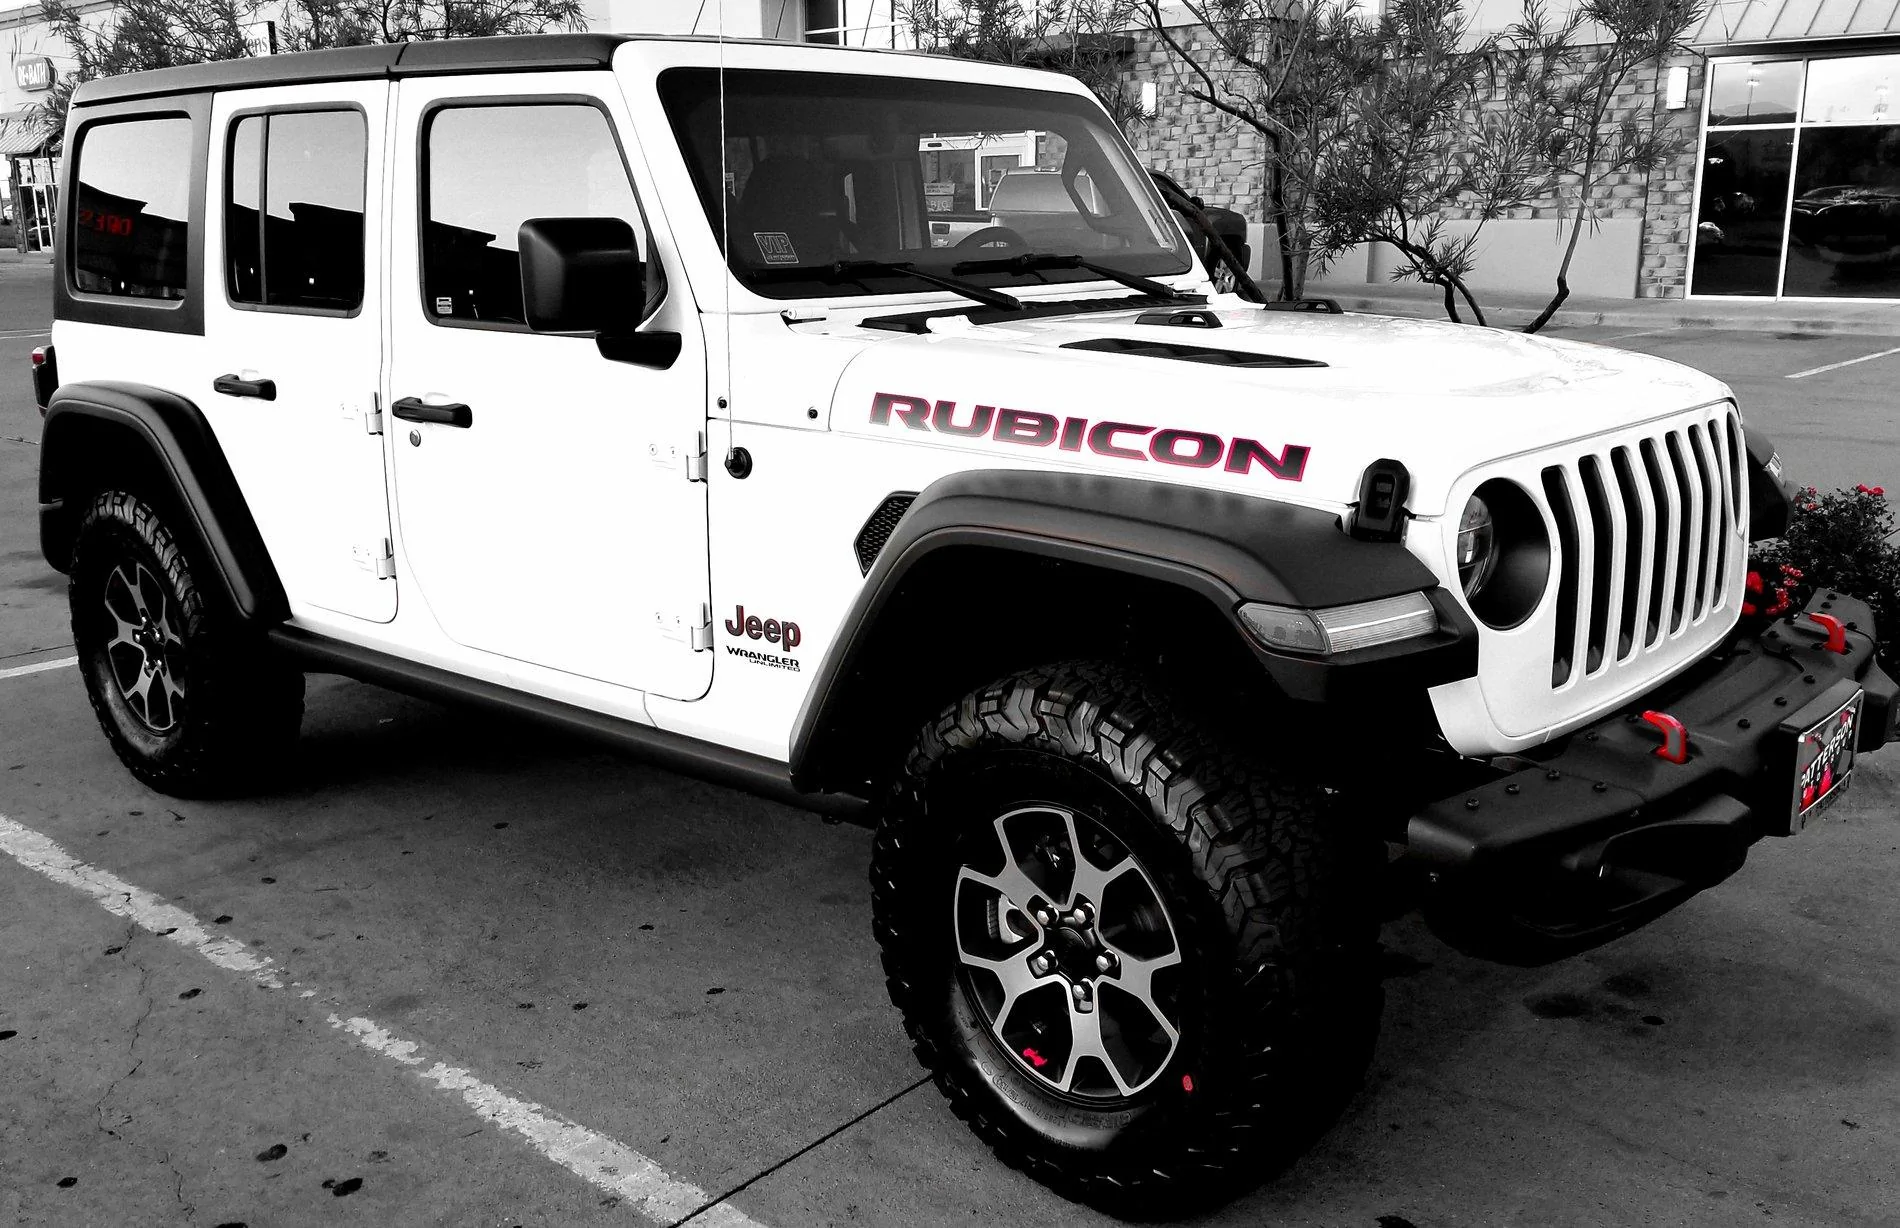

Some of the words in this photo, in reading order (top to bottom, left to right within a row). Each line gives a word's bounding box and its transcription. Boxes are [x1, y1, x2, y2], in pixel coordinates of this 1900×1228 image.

[868, 391, 1311, 482] RUBICON
[725, 604, 802, 652] Jeep
[726, 645, 800, 668] WRANGLER
[749, 658, 801, 673] UNLIMITED
